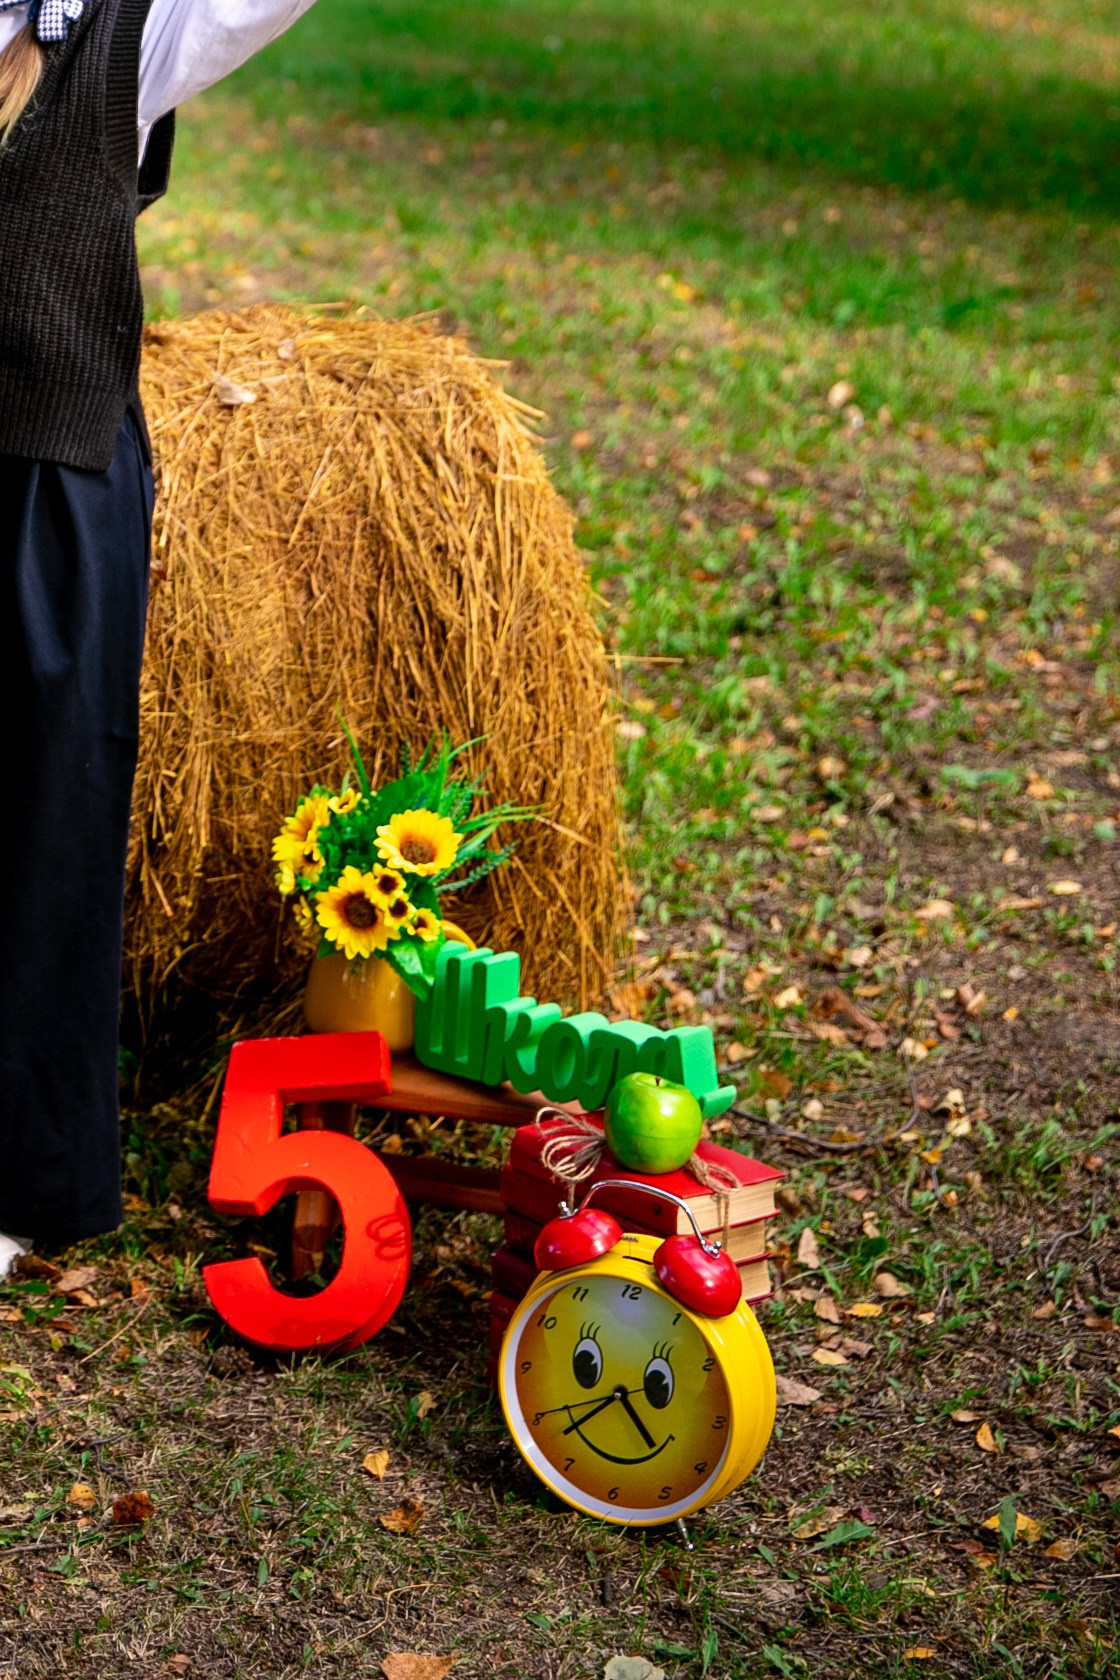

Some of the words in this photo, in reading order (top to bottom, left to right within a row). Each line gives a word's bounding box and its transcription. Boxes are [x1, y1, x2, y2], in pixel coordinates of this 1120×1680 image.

[202, 1030, 413, 1354] 5
[572, 1286, 590, 1302] 11
[620, 1284, 643, 1301] 12
[537, 1313, 557, 1330] 10
[671, 1312, 681, 1327] 1
[520, 1361, 532, 1375] 9
[702, 1358, 716, 1372] 2
[712, 1415, 727, 1429] 3
[563, 1457, 576, 1472] 7
[694, 1461, 708, 1475] 4
[607, 1486, 620, 1502] 6
[658, 1485, 674, 1500] 5
